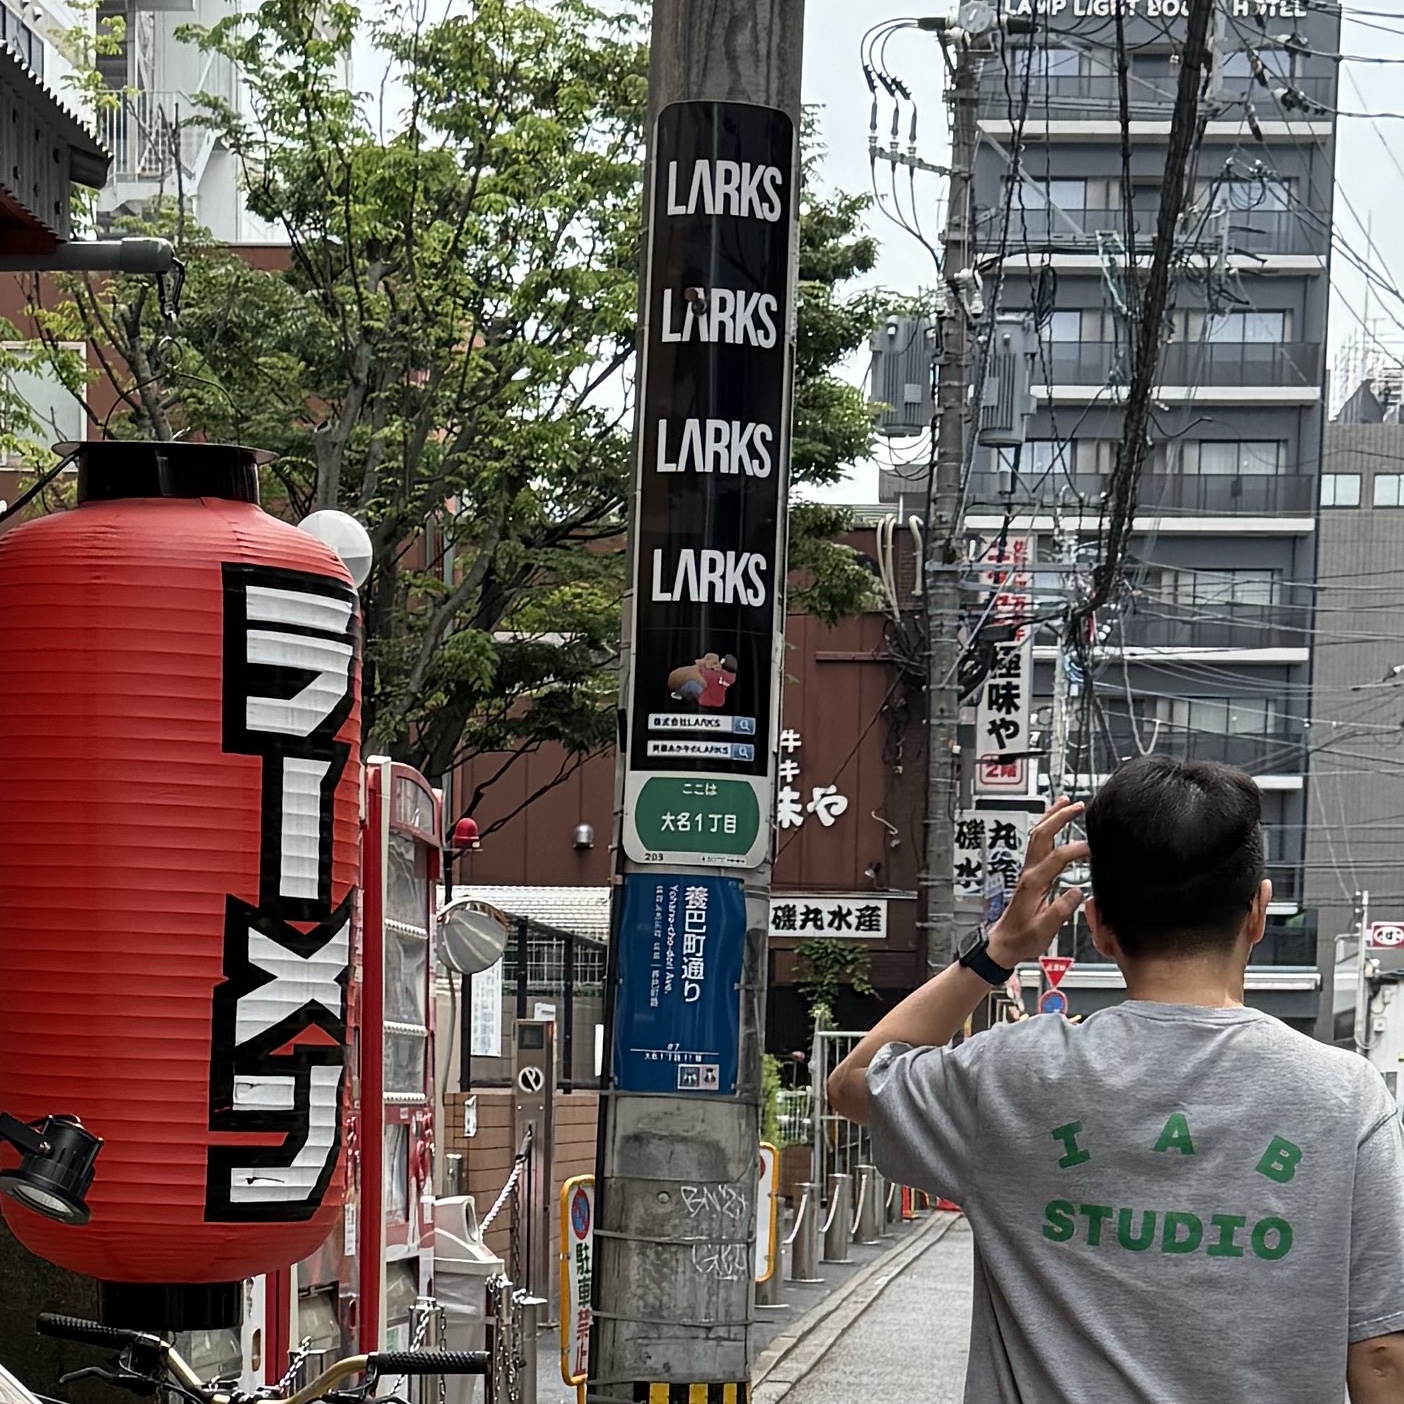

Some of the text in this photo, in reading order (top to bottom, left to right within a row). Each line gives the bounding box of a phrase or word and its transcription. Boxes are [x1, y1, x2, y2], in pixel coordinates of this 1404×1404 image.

[667, 158, 783, 223] LARKS
[661, 287, 778, 350] LARKS
[656, 418, 773, 479] LARKS
[651, 548, 767, 607] LARKS
[682, 783, 718, 796] ここは
[644, 852, 664, 862] 203
[228, 580, 356, 1206] ラーメン
[770, 903, 883, 933] 磯丸水産
[680, 885, 709, 1003] 養巴町通り
[1042, 1199, 1294, 1261] STUDIO
[573, 1241, 593, 1377] 駐車禁止
